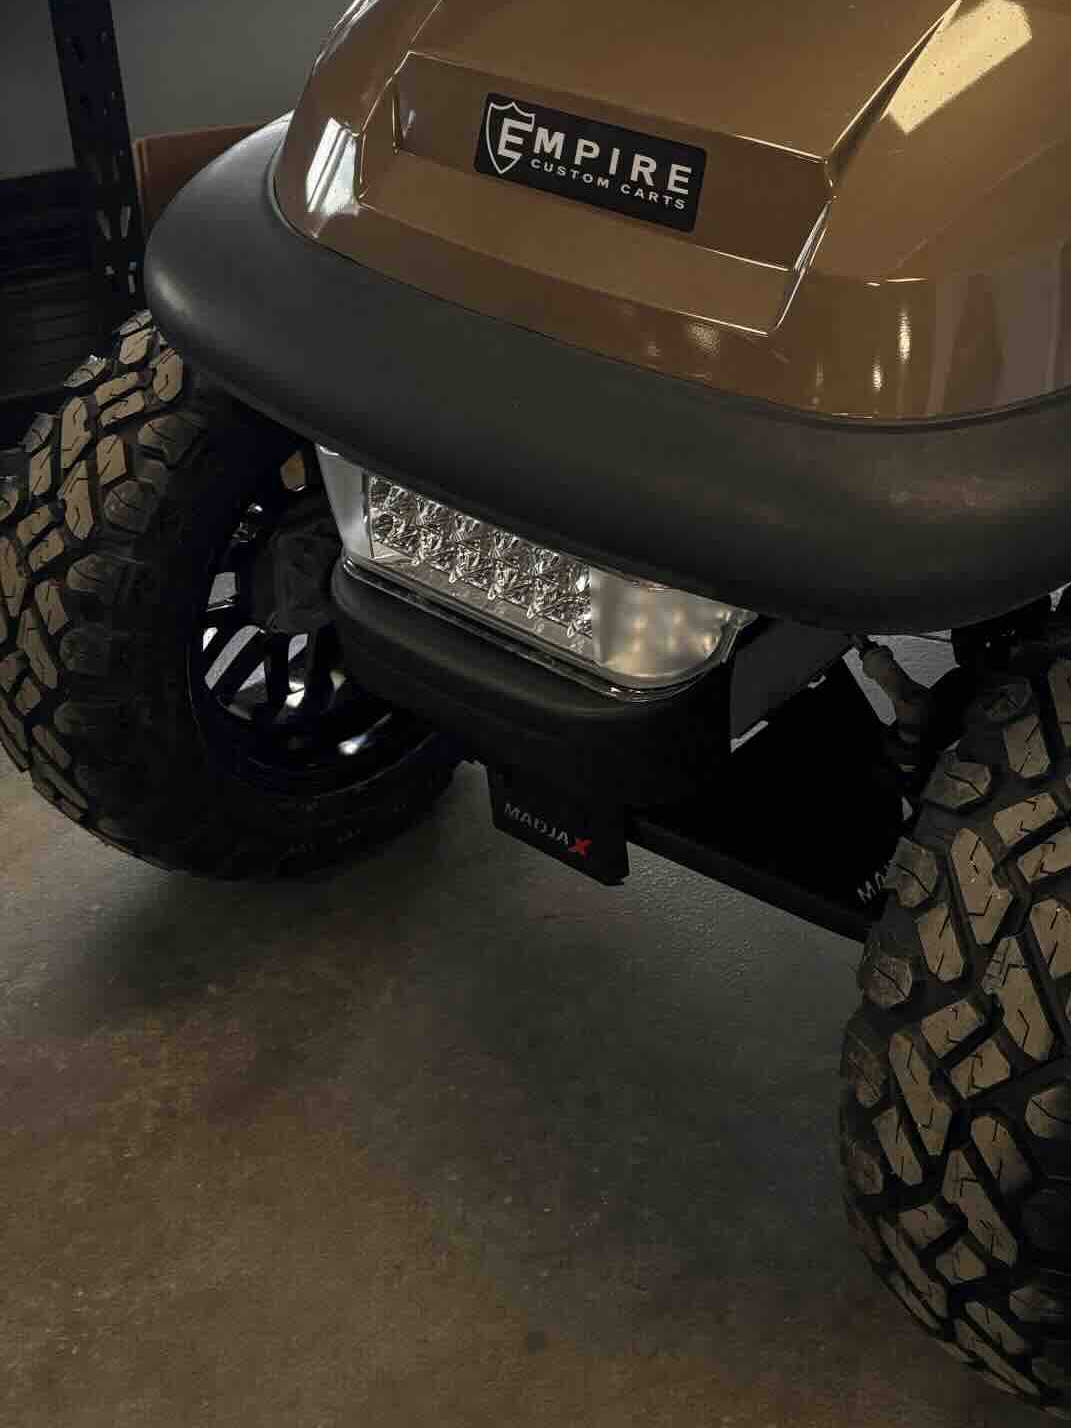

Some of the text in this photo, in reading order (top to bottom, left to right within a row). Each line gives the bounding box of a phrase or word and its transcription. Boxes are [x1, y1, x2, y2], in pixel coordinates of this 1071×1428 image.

[496, 116, 693, 196] EMPIRE
[530, 157, 686, 210] CUSTOM CARTS
